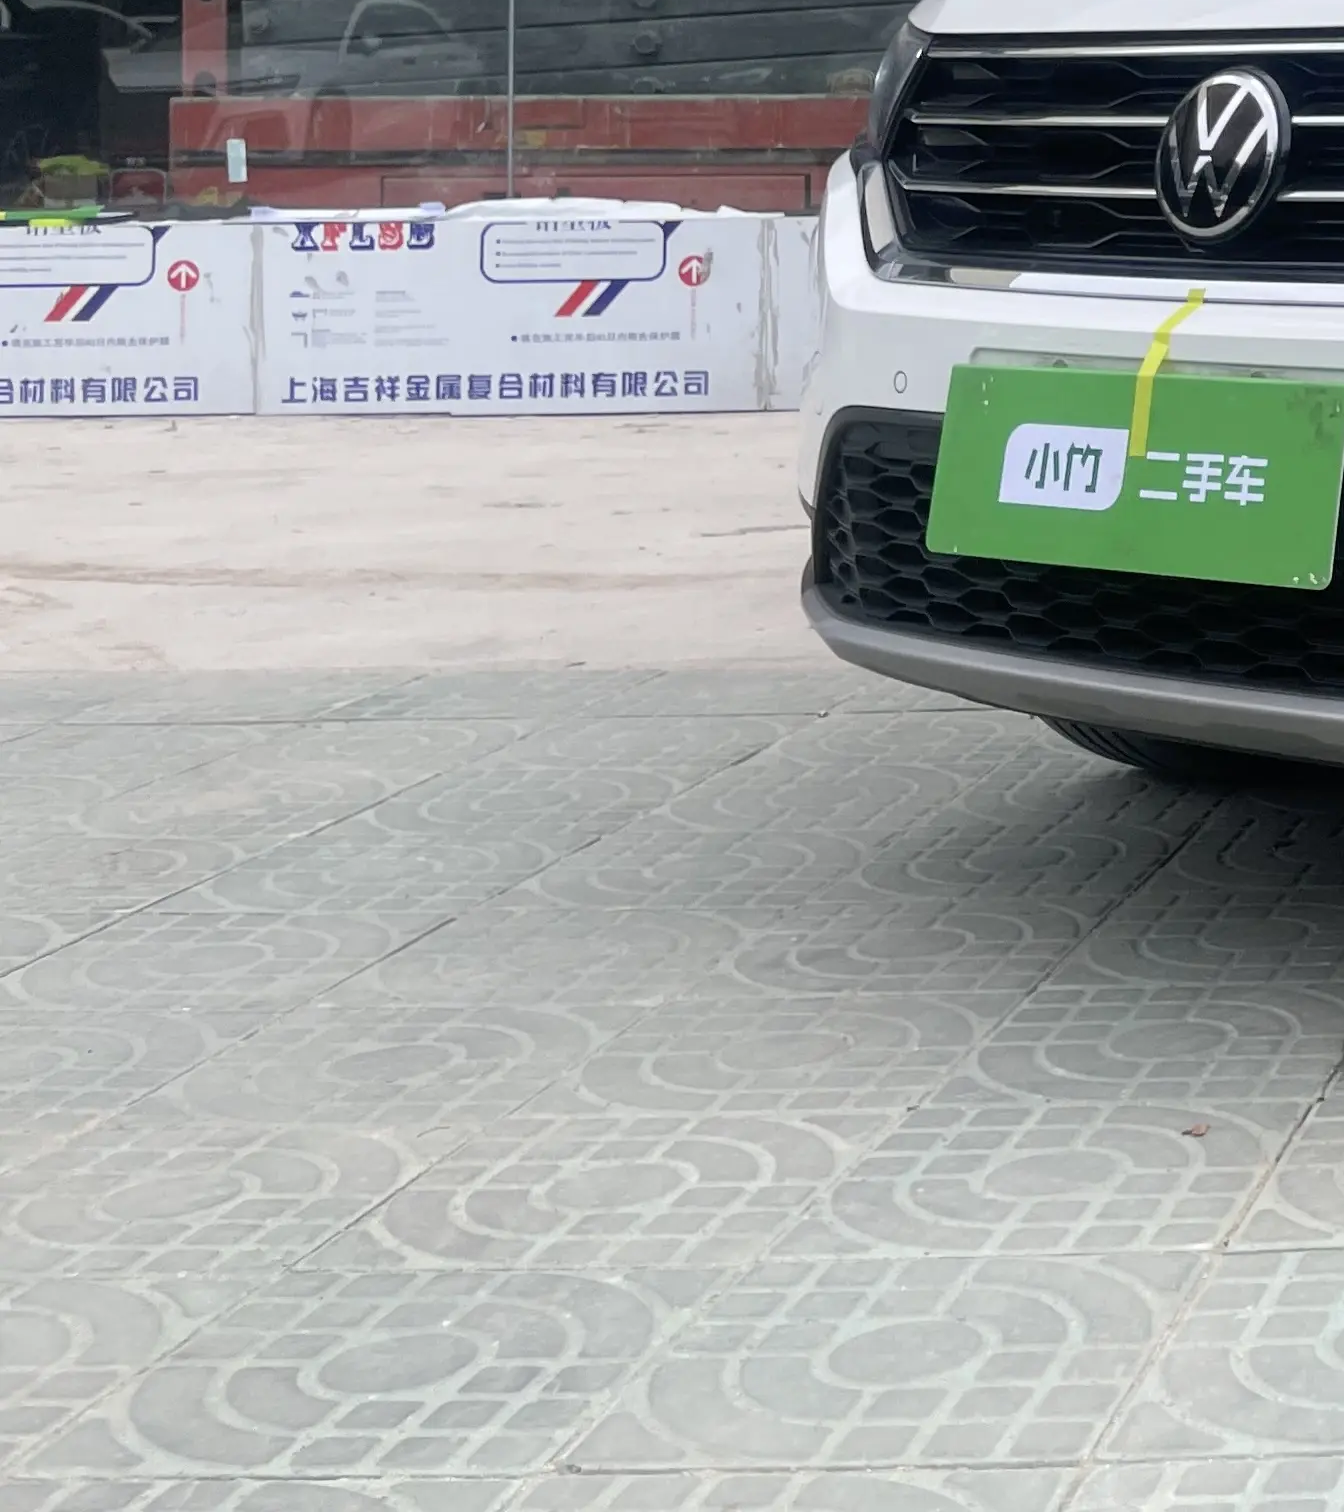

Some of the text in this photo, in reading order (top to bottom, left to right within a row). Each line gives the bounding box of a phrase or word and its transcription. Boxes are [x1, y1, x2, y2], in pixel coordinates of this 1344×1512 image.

[281, 369, 710, 404] 上海吉祥金属复合材料有限公司
[1024, 441, 1269, 507] 小竹 二手车
